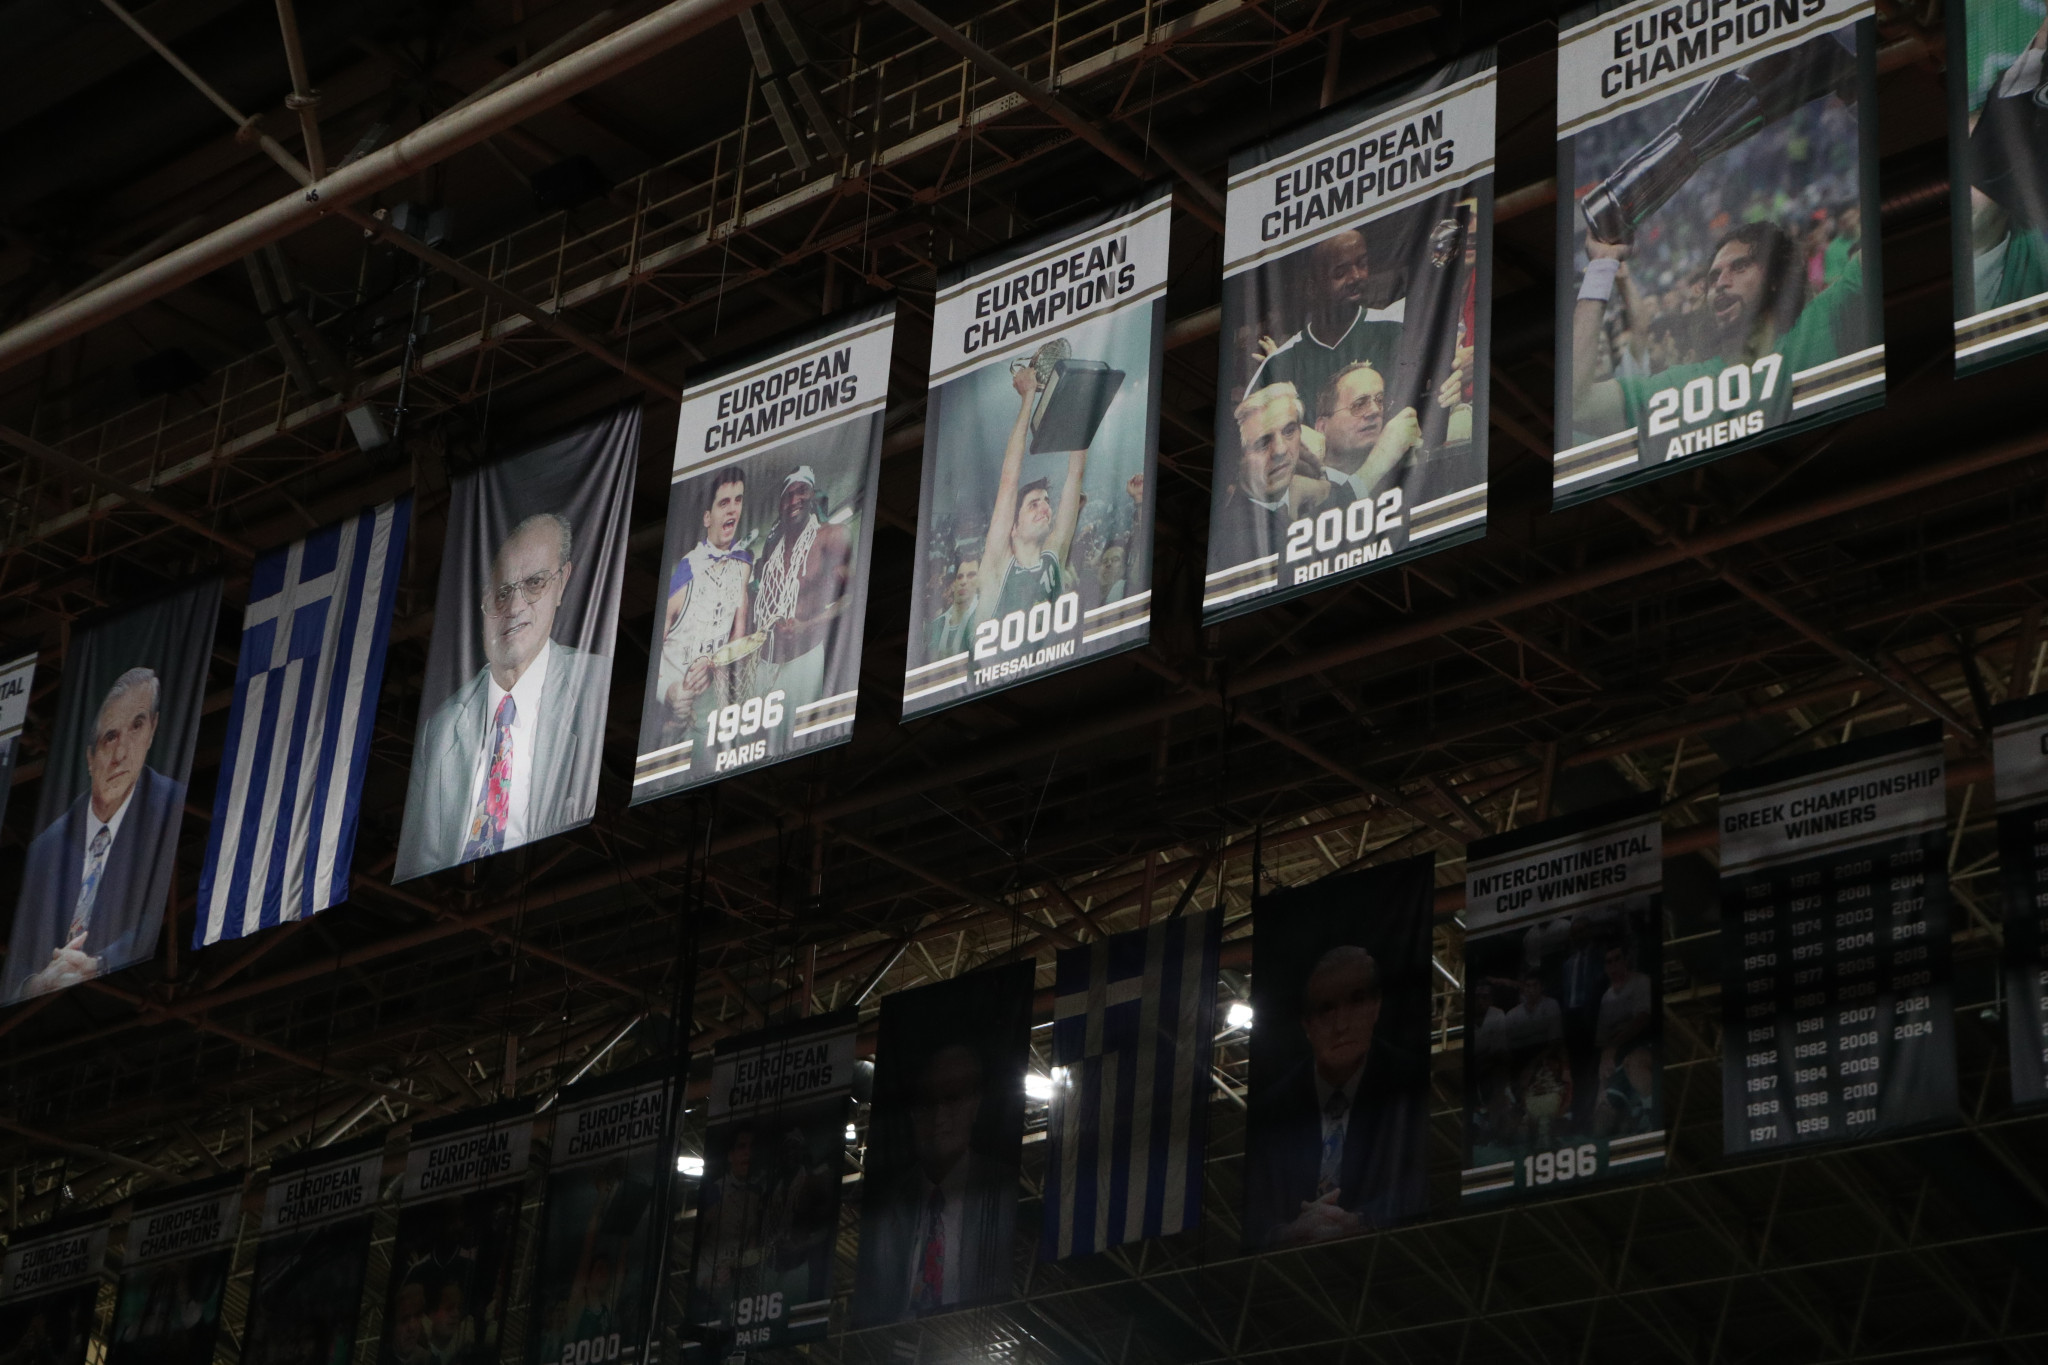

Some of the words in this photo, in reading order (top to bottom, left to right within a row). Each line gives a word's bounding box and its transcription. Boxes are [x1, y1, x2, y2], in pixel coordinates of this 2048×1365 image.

[1614, 0, 1746, 59] EUROP
[1274, 110, 1444, 205] EUROPEAN
[1261, 139, 1454, 242] CHAMPIONS
[976, 235, 1127, 319] EUROPEAN
[964, 263, 1135, 353] CHAMPIONS
[717, 347, 852, 420] EUROPEAN
[1648, 353, 1783, 438] 2007
[704, 375, 858, 453] CHAMPIONS
[1664, 409, 1764, 462] ATHENS
[1286, 486, 1403, 563] 2002
[1294, 537, 1393, 585] BOLOGNA
[973, 591, 1079, 661] 2000
[974, 639, 1075, 685] THESSALONIKI
[706, 690, 785, 747] 1996
[715, 739, 767, 772] PARIS
[1724, 804, 1784, 833] GREEK
[1790, 767, 1940, 818] CHAMPIONSHIP
[1785, 804, 1877, 840] WINNERS
[1473, 835, 1653, 898] INTERCONTINENTAL
[1790, 871, 1821, 889] 1972
[1834, 859, 1872, 879] 2000
[1496, 886, 1533, 913] CUP
[1538, 864, 1627, 904] WINNERS
[1791, 895, 1822, 912] 1973
[1836, 885, 1872, 903] 2001
[1890, 872, 1925, 891] 2014
[1744, 930, 1775, 946] 1947
[1791, 919, 1822, 936] 1974
[1835, 908, 1874, 927] 2003
[1891, 896, 1925, 915] 2017
[1744, 953, 1776, 971] 1950
[1792, 943, 1824, 960] 1975
[1836, 931, 1875, 951] 2004
[1891, 920, 1928, 940] 2018
[1747, 977, 1775, 994] 1951
[1794, 967, 1824, 984] 1977
[1836, 956, 1875, 976] 2005
[1892, 970, 1931, 990] 2020
[1747, 1025, 1775, 1043] 1961
[1796, 1016, 1825, 1035] 1981
[1839, 1006, 1877, 1025] 2007
[1895, 995, 1930, 1015] 2021
[737, 1044, 828, 1083] EUROPEAN
[1745, 1050, 1778, 1068] 1962
[1794, 1041, 1828, 1059] 1982
[1839, 1031, 1879, 1051] 2008
[1894, 1020, 1934, 1040] 2024
[729, 1064, 832, 1107] CHAMPIONS
[1746, 1075, 1778, 1093] 1967
[1794, 1065, 1828, 1084] 1984
[1839, 1056, 1880, 1076] 2009
[578, 1094, 662, 1133] EUROPEAN
[1746, 1099, 1780, 1118] 1969
[1795, 1091, 1829, 1109] 1998
[1842, 1082, 1879, 1101] 2010
[568, 1115, 663, 1155] CHAMPIONS
[1750, 1125, 1777, 1142] 1971
[1795, 1115, 1829, 1134] 1999
[1845, 1107, 1877, 1126] 2011
[420, 1151, 511, 1190] CHAMPIONS
[428, 1132, 508, 1168] EUROPEAN
[1523, 1144, 1598, 1188] 1996
[278, 1186, 362, 1224] CHAMPIONS
[286, 1167, 361, 1201] EUROPEAN
[140, 1221, 222, 1257] CHAMPIONS
[148, 1203, 219, 1236] EUROPEAN
[13, 1256, 89, 1290] CHAMPIONS
[22, 1238, 88, 1269] EUROPEAN
[562, 1332, 620, 1365] 2000
